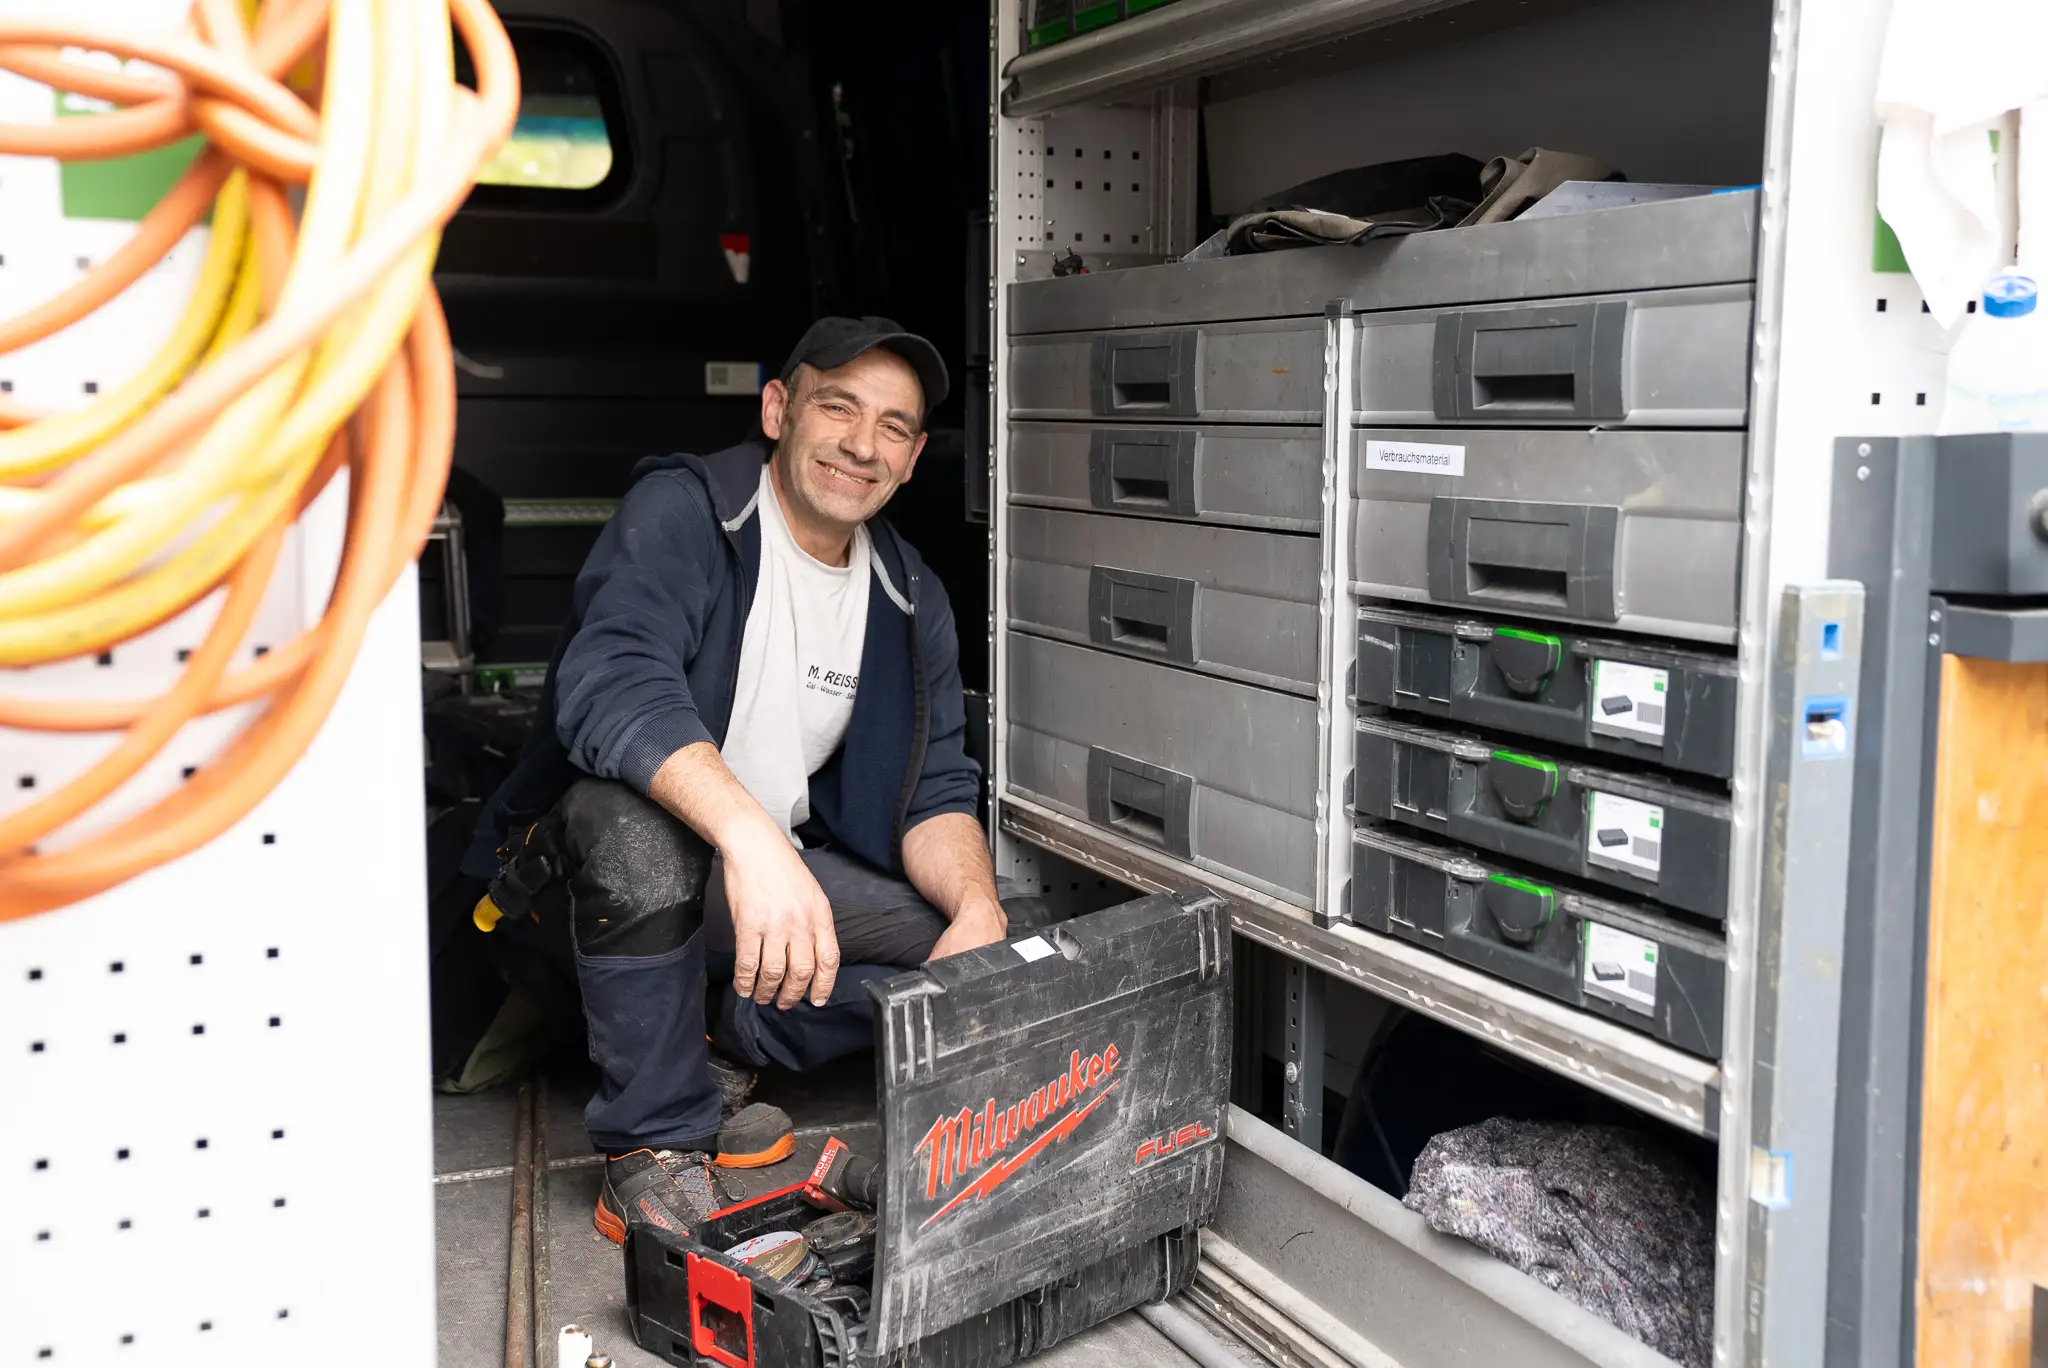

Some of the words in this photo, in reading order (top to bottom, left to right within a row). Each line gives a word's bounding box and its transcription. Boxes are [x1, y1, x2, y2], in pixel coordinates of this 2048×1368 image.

[1379, 447, 1451, 466] Verbrauchsmaterial
[807, 664, 820, 680] M.
[824, 670, 858, 690] REISS
[820, 685, 843, 697] Wasser
[913, 1043, 1121, 1200] Milwaukee
[1135, 1120, 1212, 1165] FUEL
[813, 1149, 833, 1177] FUEL
